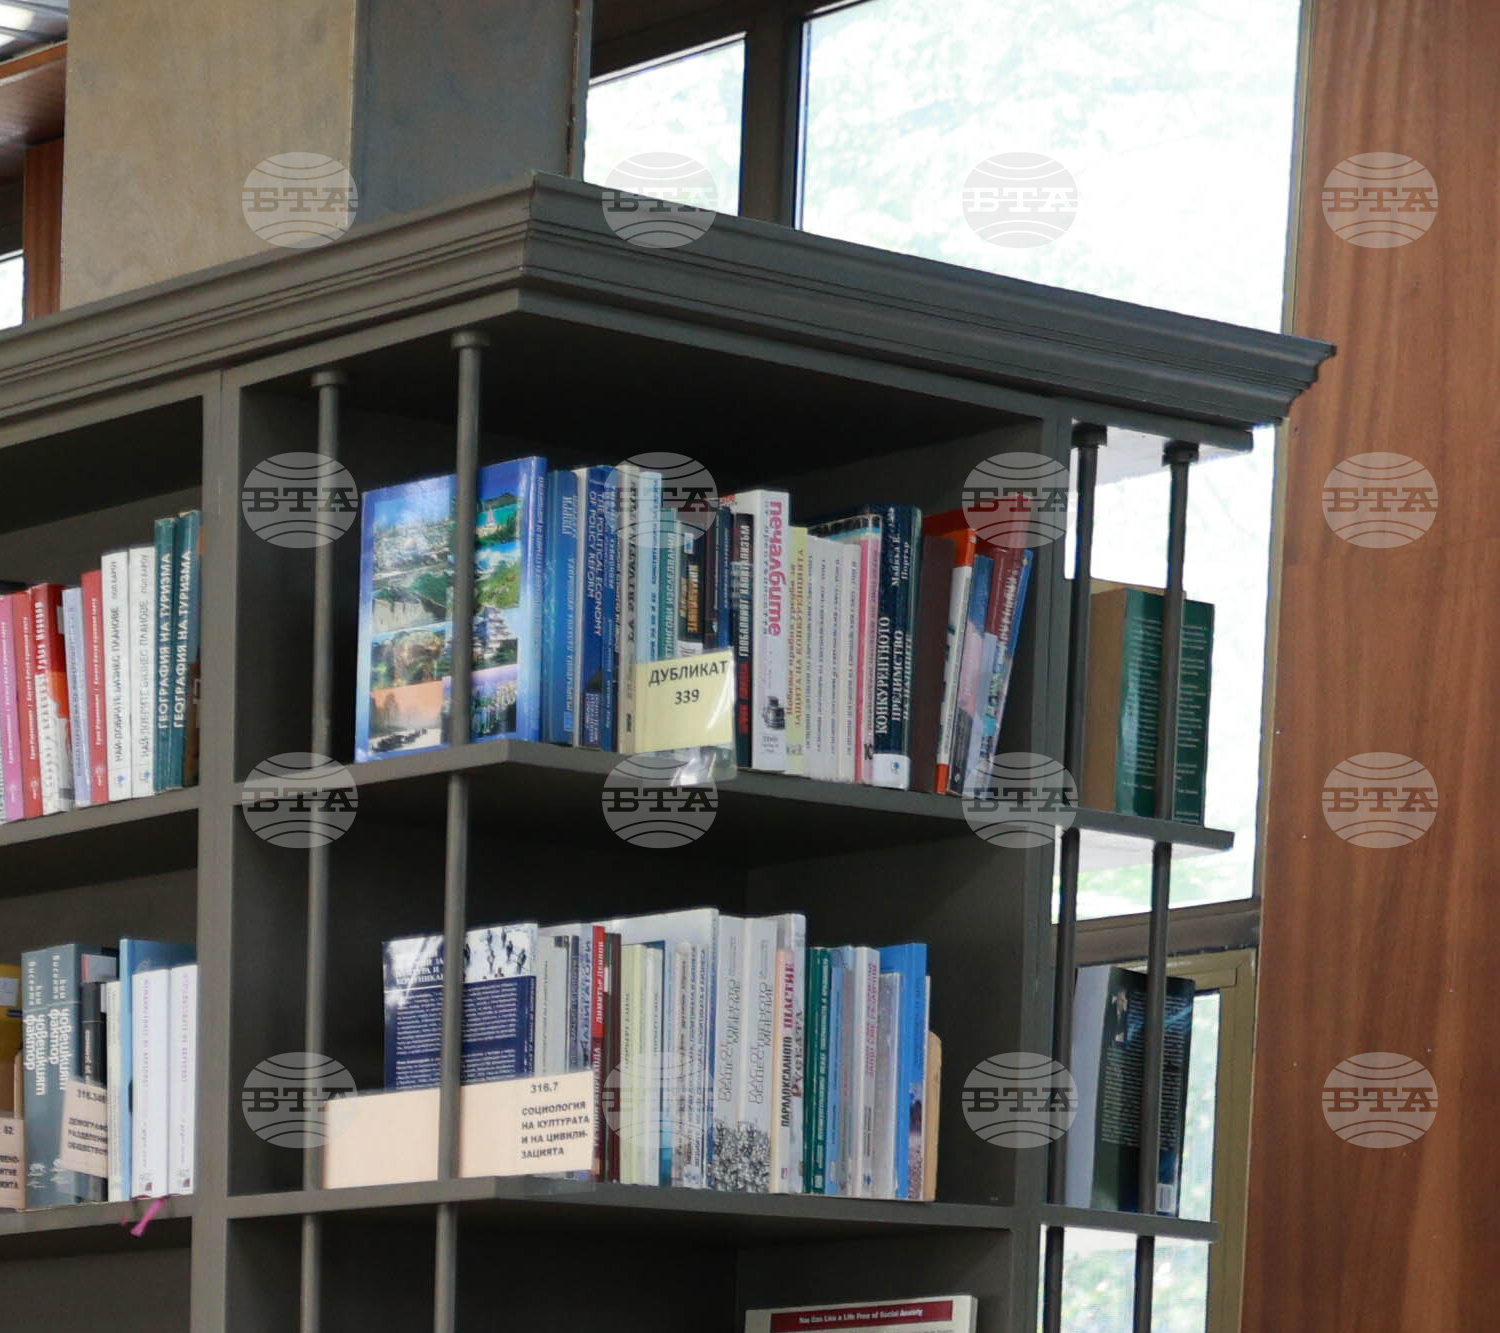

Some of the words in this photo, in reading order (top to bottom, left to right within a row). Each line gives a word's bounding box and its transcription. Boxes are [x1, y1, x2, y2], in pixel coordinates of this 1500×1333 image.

[766, 500, 787, 637] печалбите
[648, 660, 729, 686] ДУБЛИКАТ
[874, 616, 890, 735] КОНКУРЕНТНОТО
[891, 629, 905, 722] ПРЕДИМСТВО
[674, 689, 700, 705] 339
[530, 1081, 559, 1094] 316.7
[521, 1101, 586, 1117] СОЦИОЛОГИЯ
[521, 1120, 535, 1131] НА
[537, 1115, 590, 1130] КУЛТУРАТА
[530, 1133, 544, 1144] НА
[521, 1147, 565, 1160] ЗАЦИЯТА
